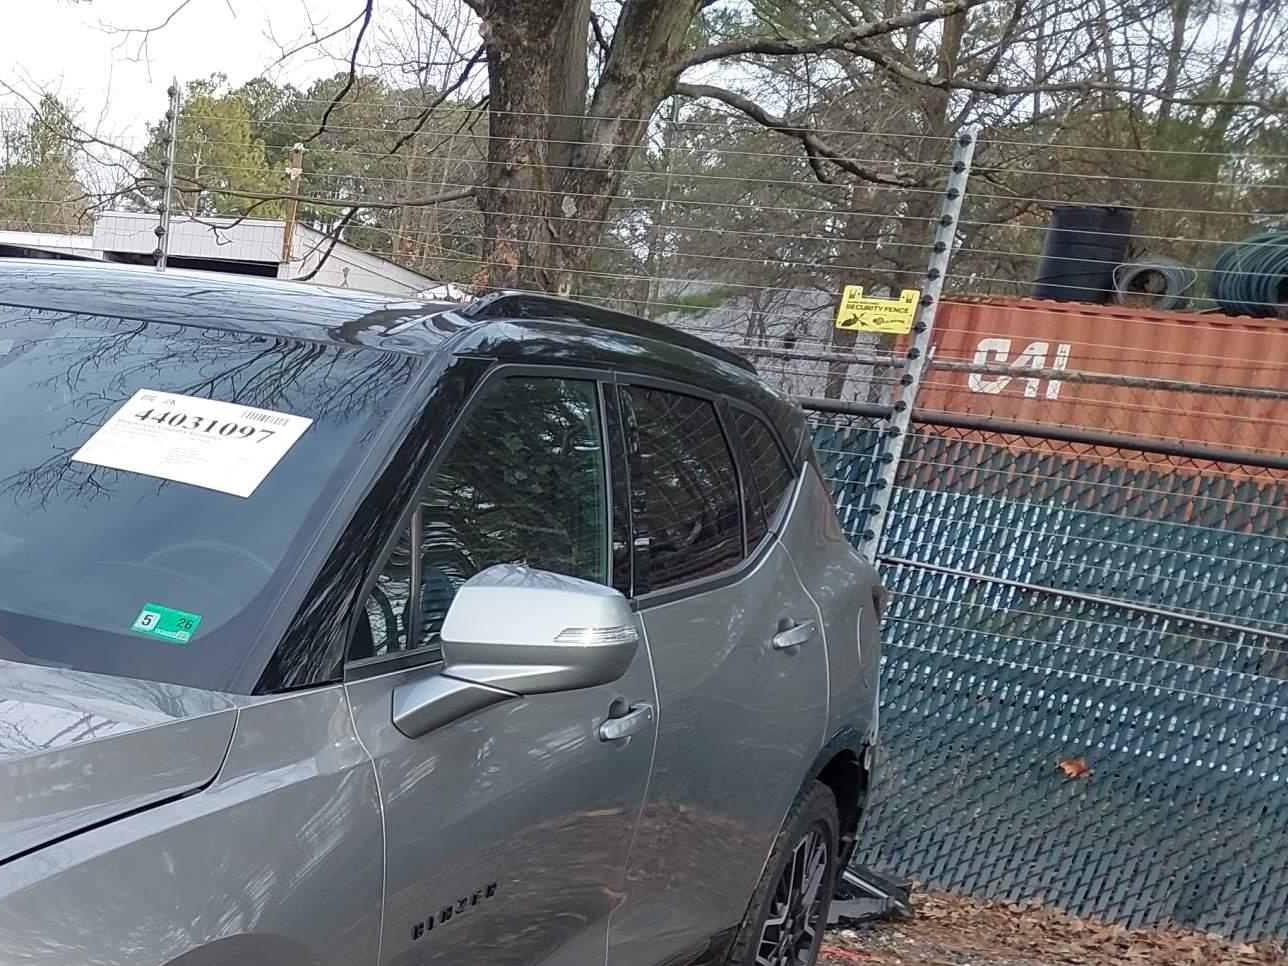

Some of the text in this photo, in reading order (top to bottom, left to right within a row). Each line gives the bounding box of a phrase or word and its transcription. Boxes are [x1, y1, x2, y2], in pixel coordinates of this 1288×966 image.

[845, 303, 910, 314] SECURITY FENCE
[135, 407, 276, 443] 44031097
[141, 614, 194, 630] 5 26
[412, 882, 497, 941] BLAZER
